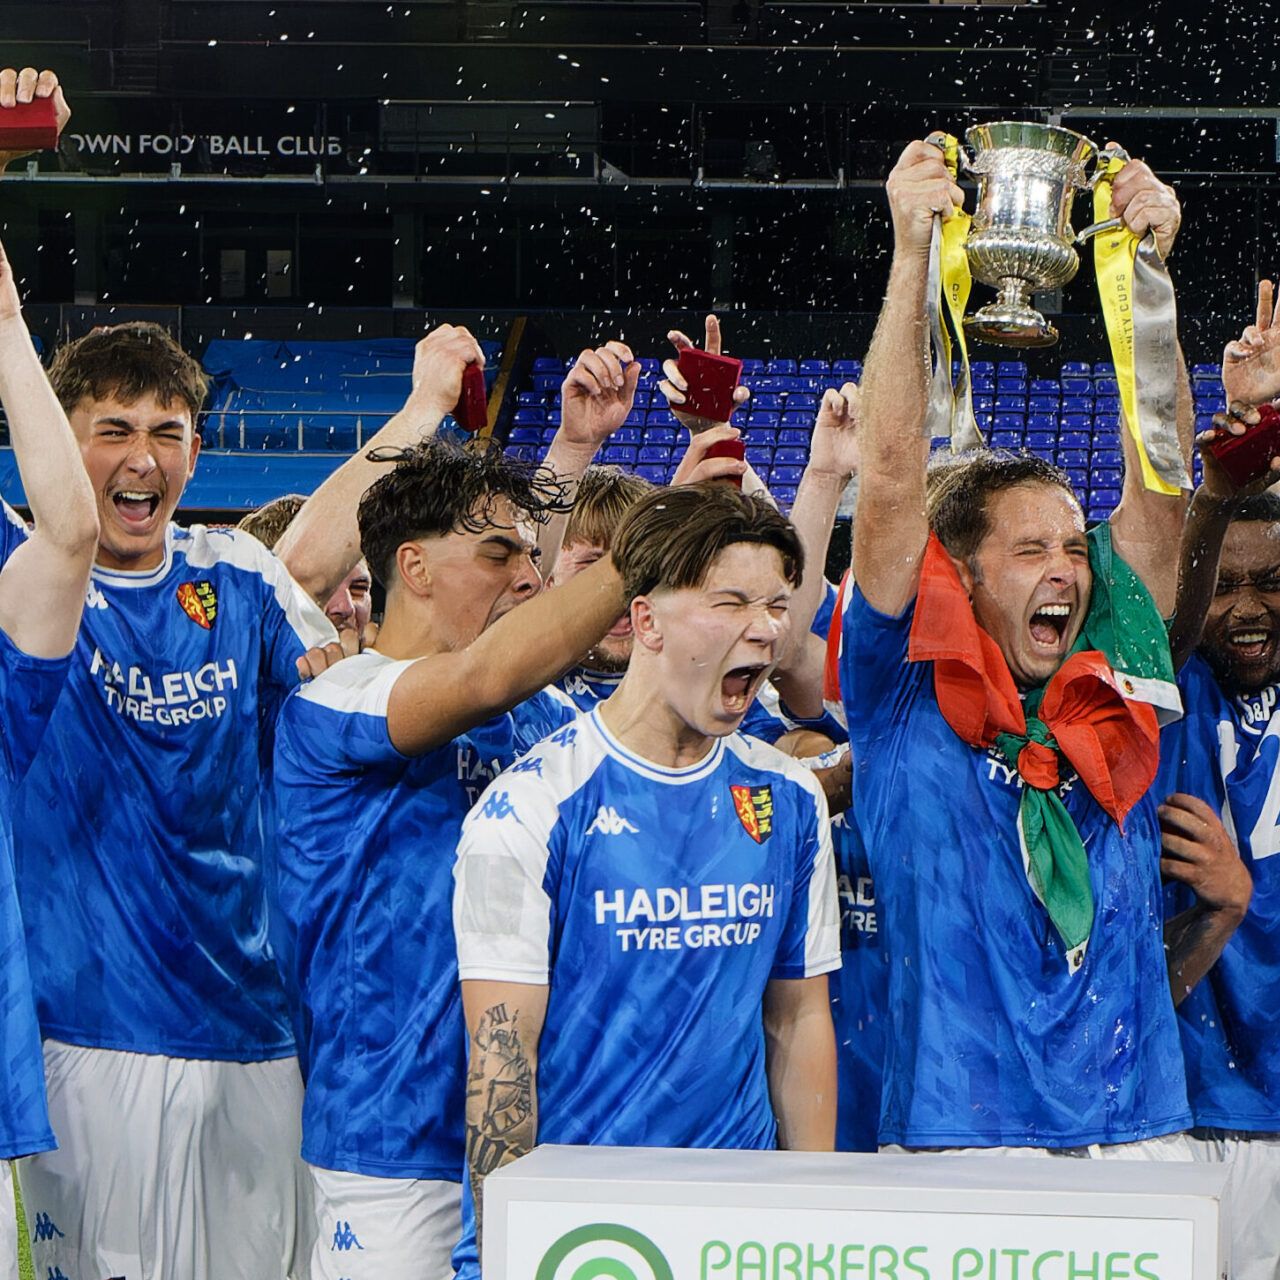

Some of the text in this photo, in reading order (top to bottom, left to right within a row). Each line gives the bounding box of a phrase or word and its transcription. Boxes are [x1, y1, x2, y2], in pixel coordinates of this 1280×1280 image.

[70, 134, 342, 155] OWN FOOBALL CLUB
[1116, 274, 1129, 312] CUPS
[594, 883, 774, 925] HADLEIGH
[616, 923, 761, 951] TYRE GROUP
